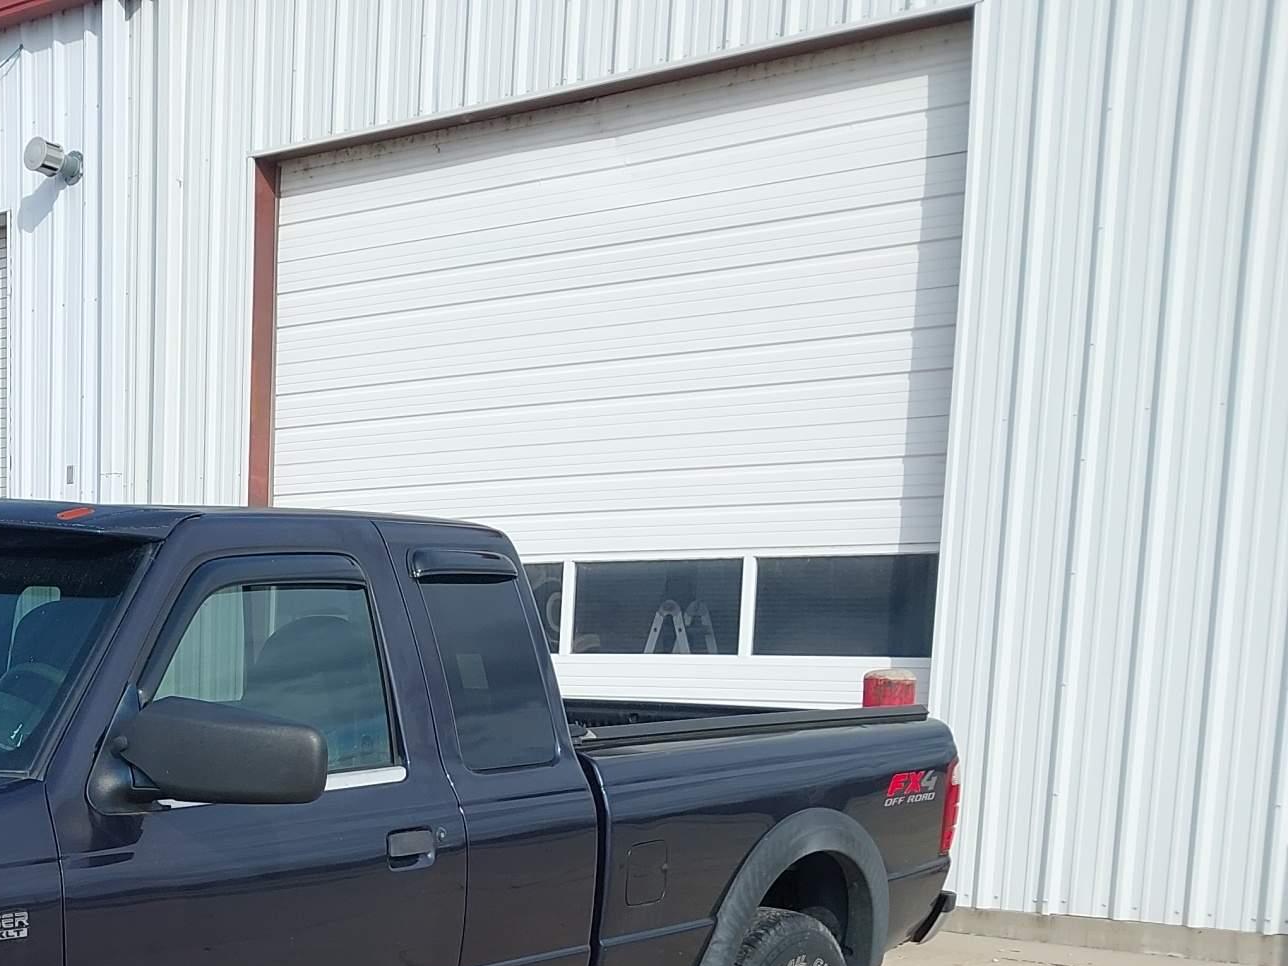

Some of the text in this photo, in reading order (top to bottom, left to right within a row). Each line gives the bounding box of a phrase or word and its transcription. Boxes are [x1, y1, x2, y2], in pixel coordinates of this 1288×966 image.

[887, 770, 938, 798] FX4
[884, 792, 936, 807] OFF ROAD
